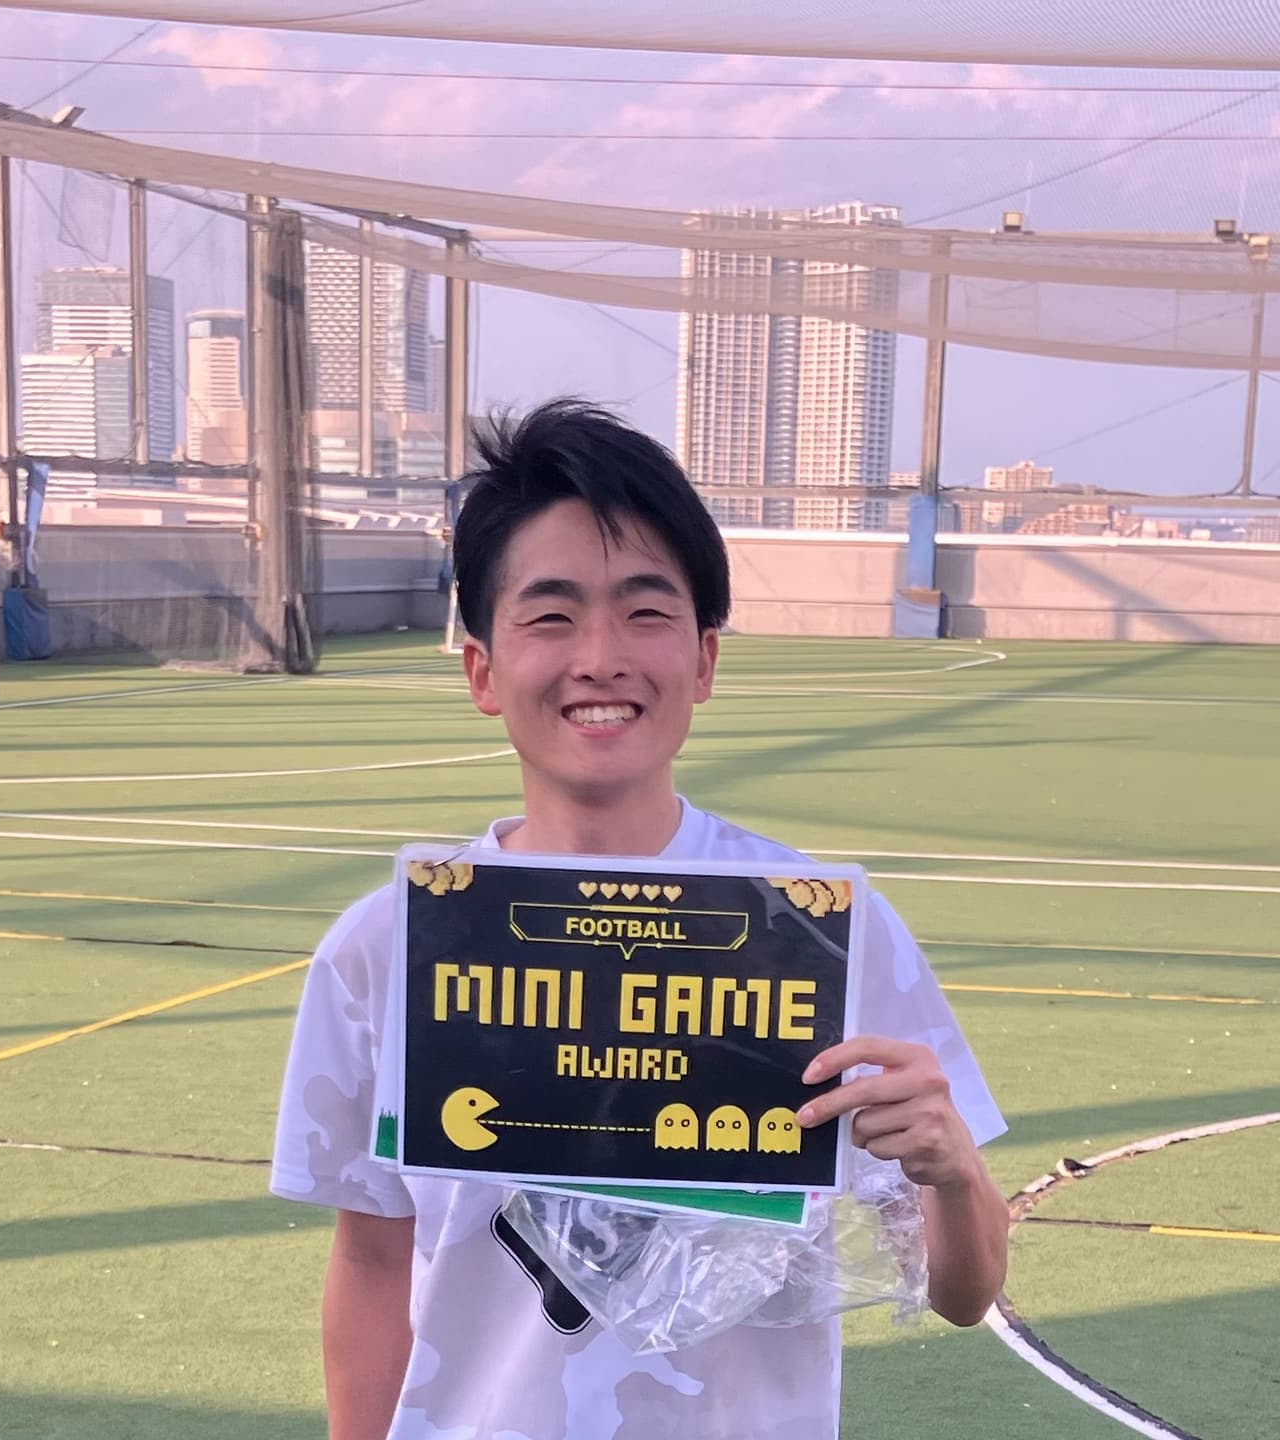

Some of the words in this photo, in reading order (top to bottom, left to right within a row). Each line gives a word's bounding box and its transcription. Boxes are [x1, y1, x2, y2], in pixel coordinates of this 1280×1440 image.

[566, 917, 687, 941] FOOTBALL
[433, 963, 584, 1030] MINI
[619, 973, 817, 1040] GAME
[557, 1045, 688, 1081] AWARD
